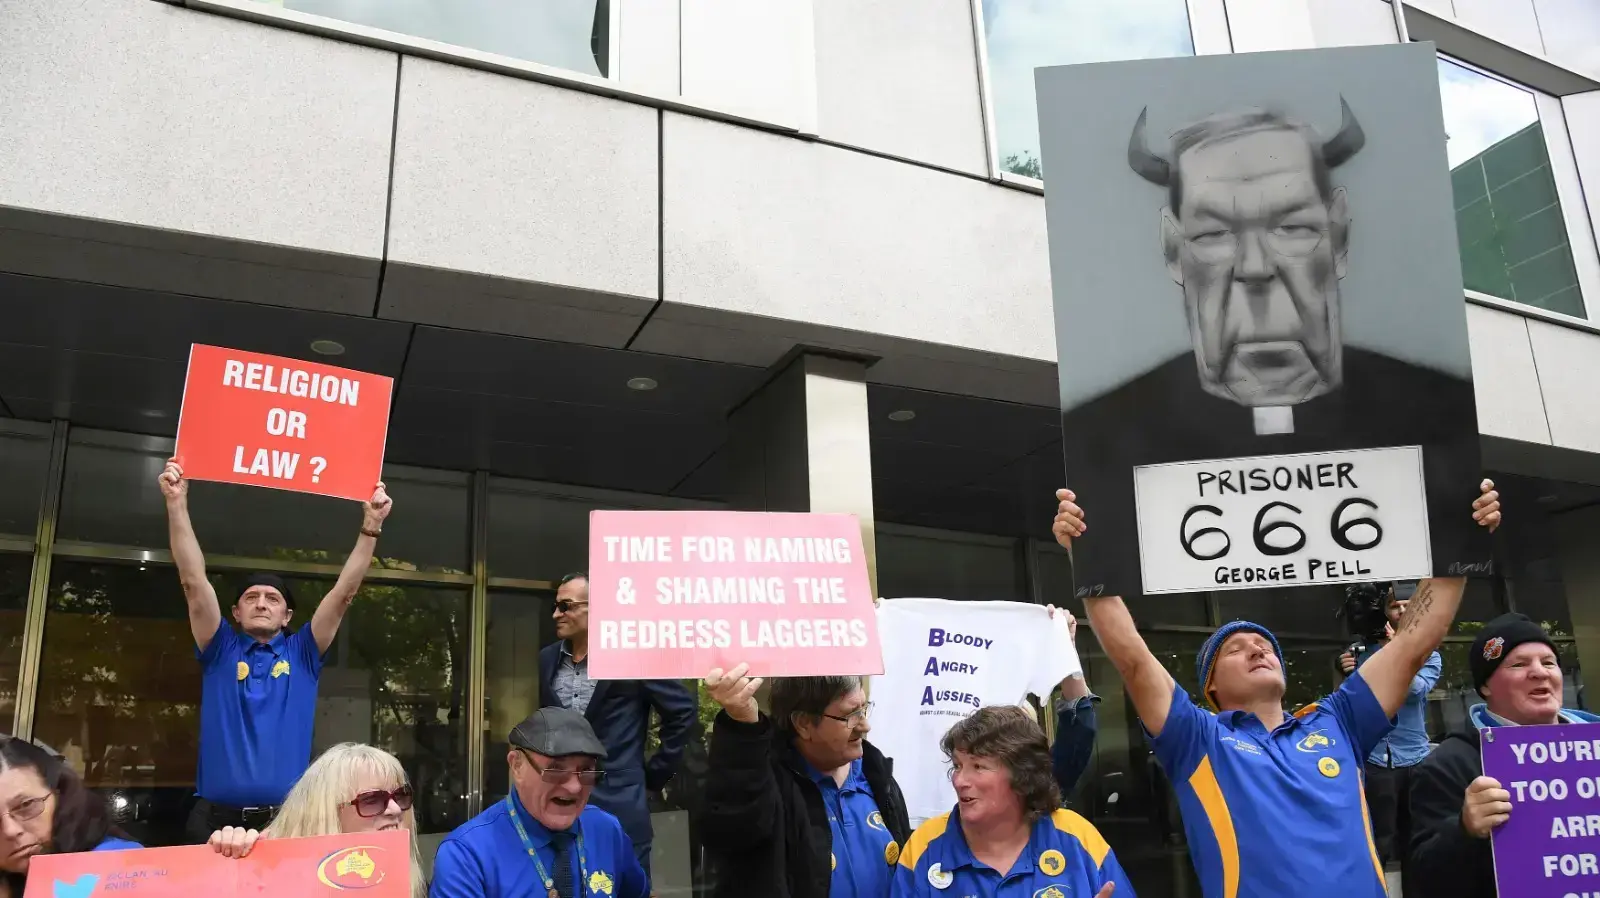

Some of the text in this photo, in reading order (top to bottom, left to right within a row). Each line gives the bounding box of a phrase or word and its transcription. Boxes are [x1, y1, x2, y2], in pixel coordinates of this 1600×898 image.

[223, 360, 360, 406] RELIGION
[266, 408, 307, 439] OR
[233, 446, 300, 480] LAW
[1197, 463, 1358, 497] PRISONER
[603, 536, 852, 563] TIME FOR NAMING
[1215, 559, 1371, 584] GEORGE PELL
[616, 576, 847, 605] & SHAMING THE
[600, 619, 868, 649] REDRESS LAGGERS
[928, 628, 993, 650] BLOODY
[924, 657, 979, 676] ANGRY
[921, 686, 981, 708] AUSSIES
[1510, 779, 1569, 802] TOO
[1543, 853, 1599, 877] FOR
